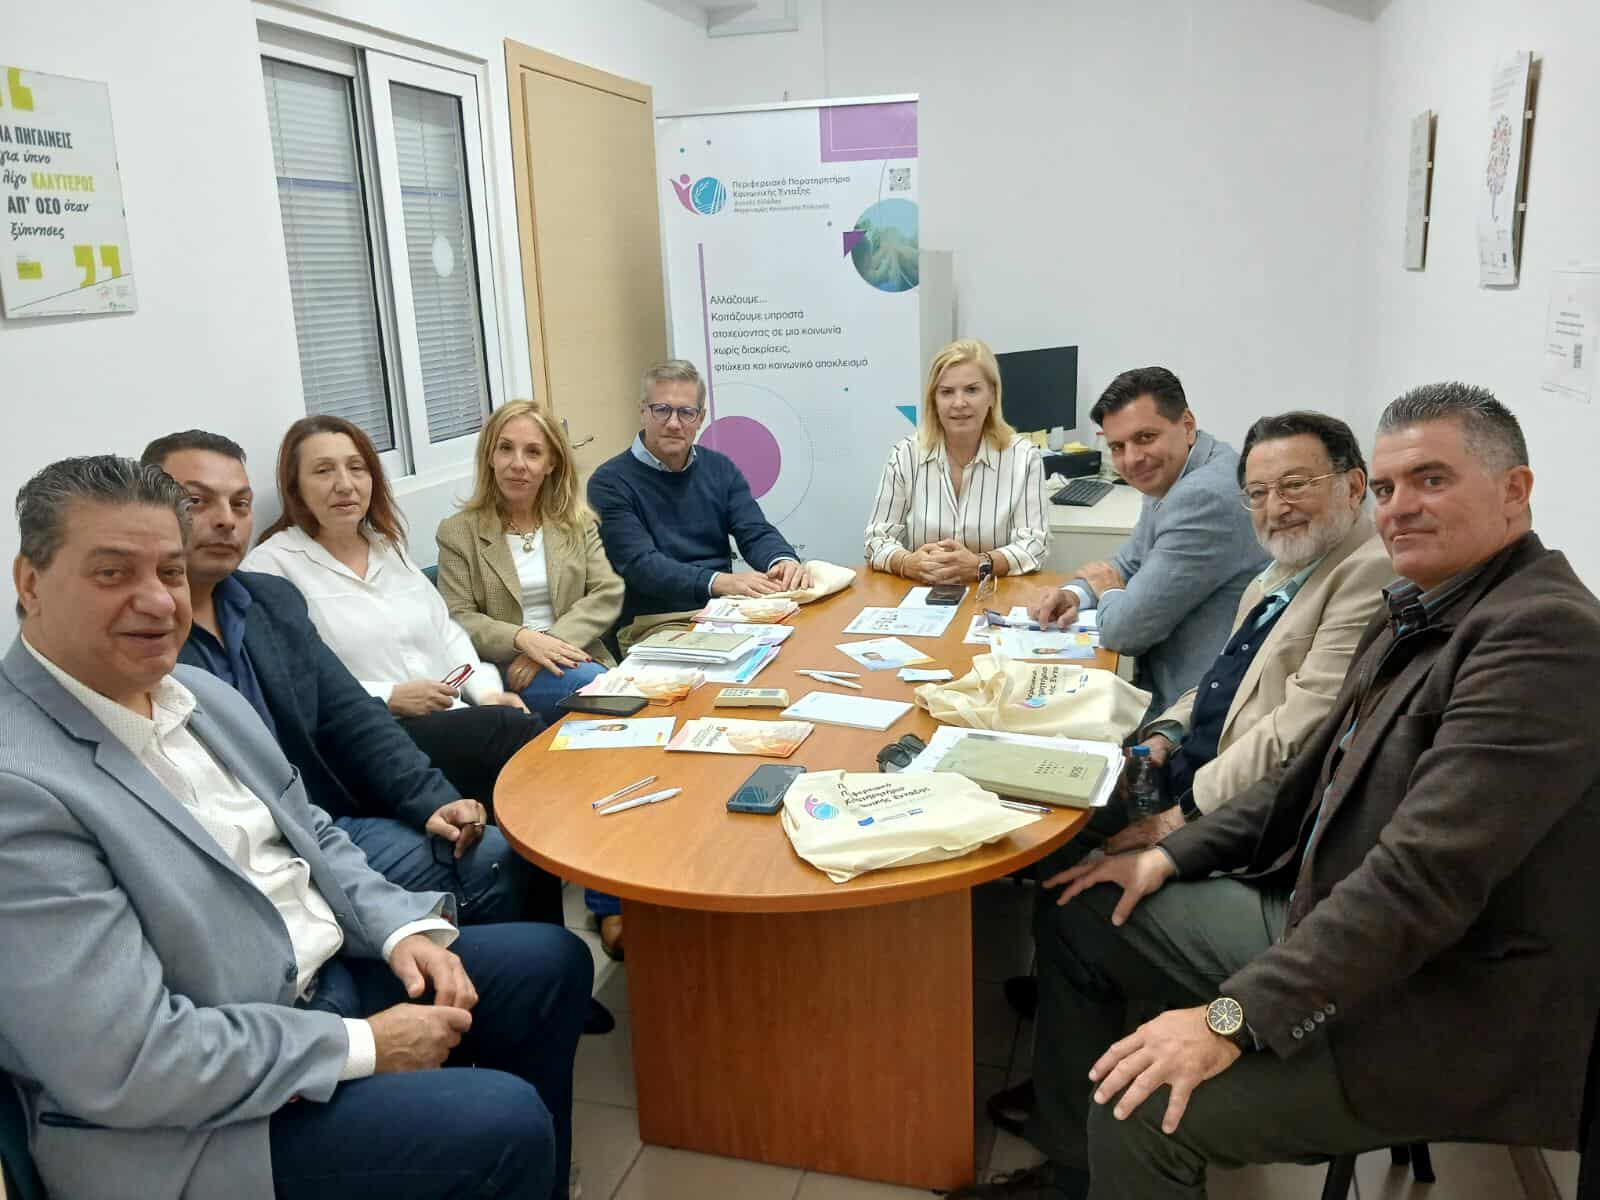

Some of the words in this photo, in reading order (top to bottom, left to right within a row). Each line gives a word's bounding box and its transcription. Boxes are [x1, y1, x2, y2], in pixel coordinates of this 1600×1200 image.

[14, 126, 73, 149] ΠΗΓΑΙΝΕΙΣ
[36, 197, 61, 215] ΟΣΟ
[711, 311, 763, 322] Κοιτάζουμε
[764, 309, 804, 322] μπροστά
[712, 328, 771, 339] στοχεύοντας
[771, 328, 783, 337] σε
[801, 325, 842, 336] κοινωνία
[713, 344, 740, 356] χωρίς
[714, 360, 751, 372] φτώχεια
[752, 361, 767, 371] και
[768, 359, 814, 370] κοινωνικό
[815, 357, 868, 369] αποκλεισμό
